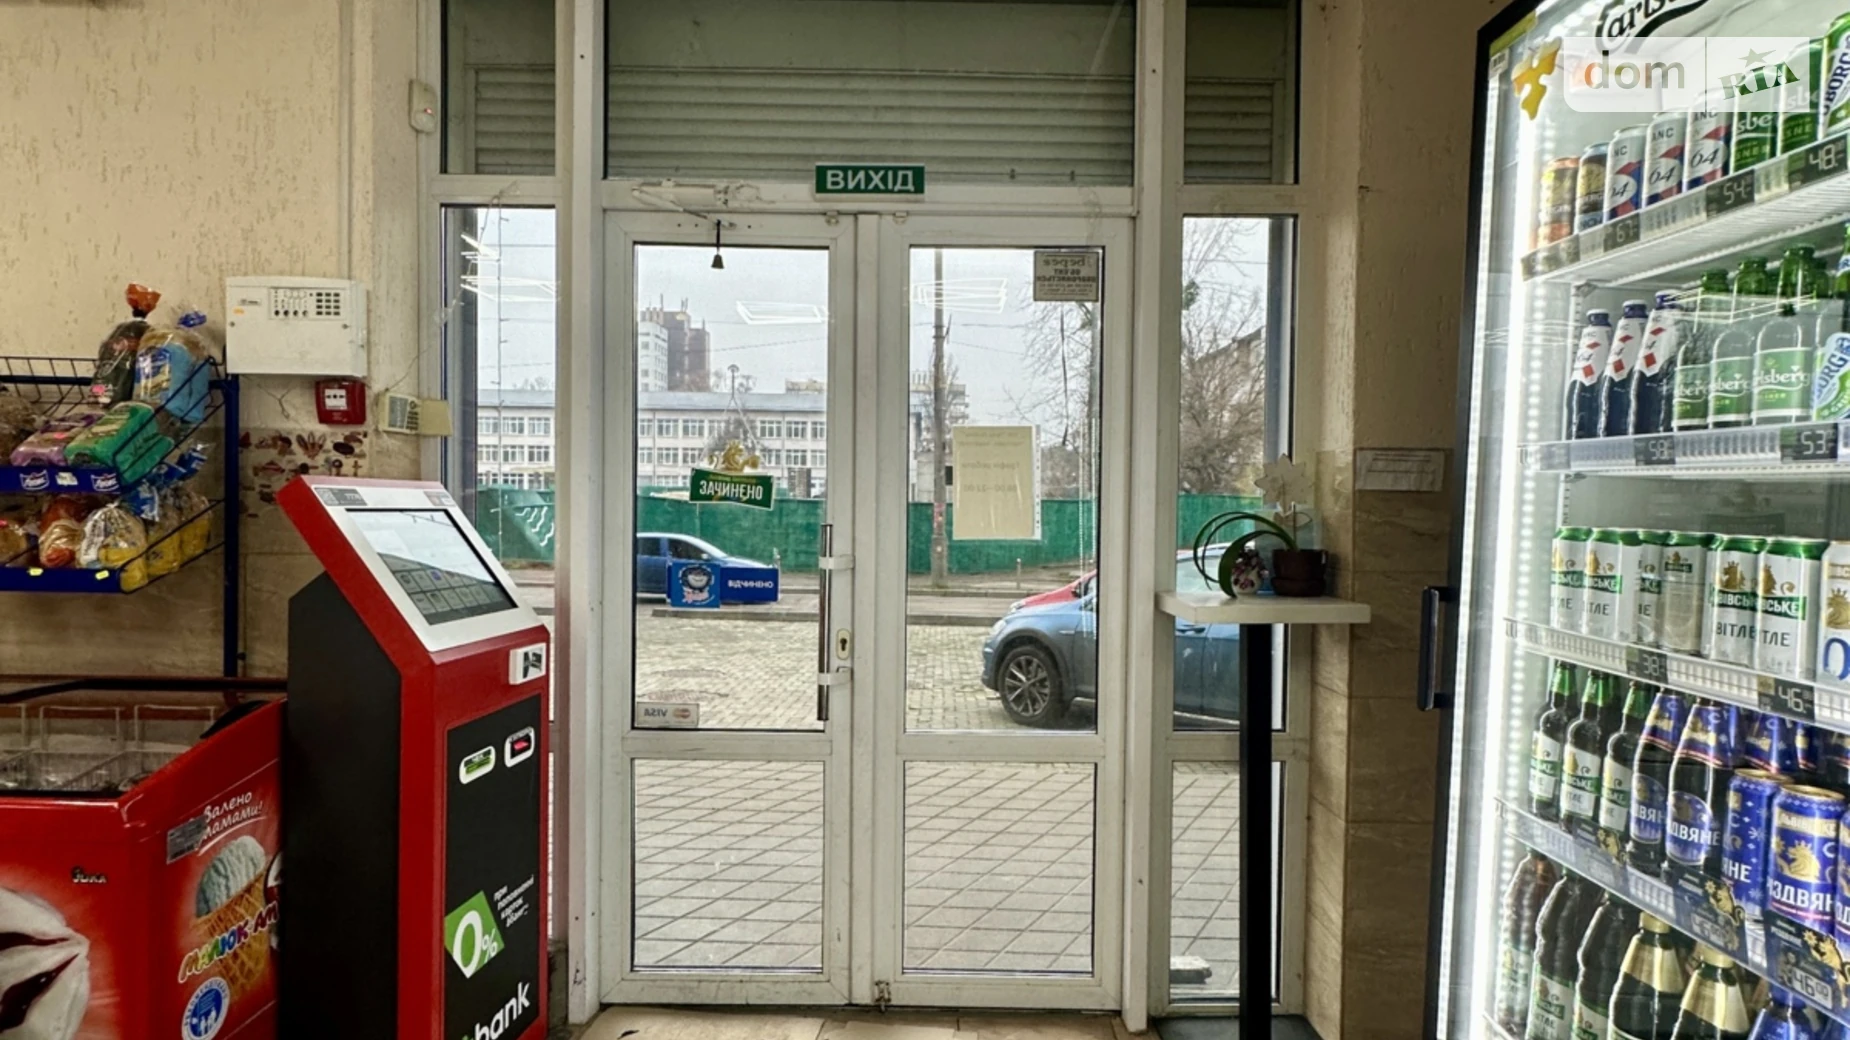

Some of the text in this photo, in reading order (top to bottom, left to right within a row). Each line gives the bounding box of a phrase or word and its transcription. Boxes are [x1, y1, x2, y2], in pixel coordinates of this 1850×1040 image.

[826, 169, 915, 192] ВИХІД
[1801, 429, 1828, 455] 53
[699, 479, 764, 500] ЗАЧИНЕНО
[1778, 685, 1804, 713] 46
[453, 909, 498, 979] 0%
[462, 981, 531, 1040] bank
